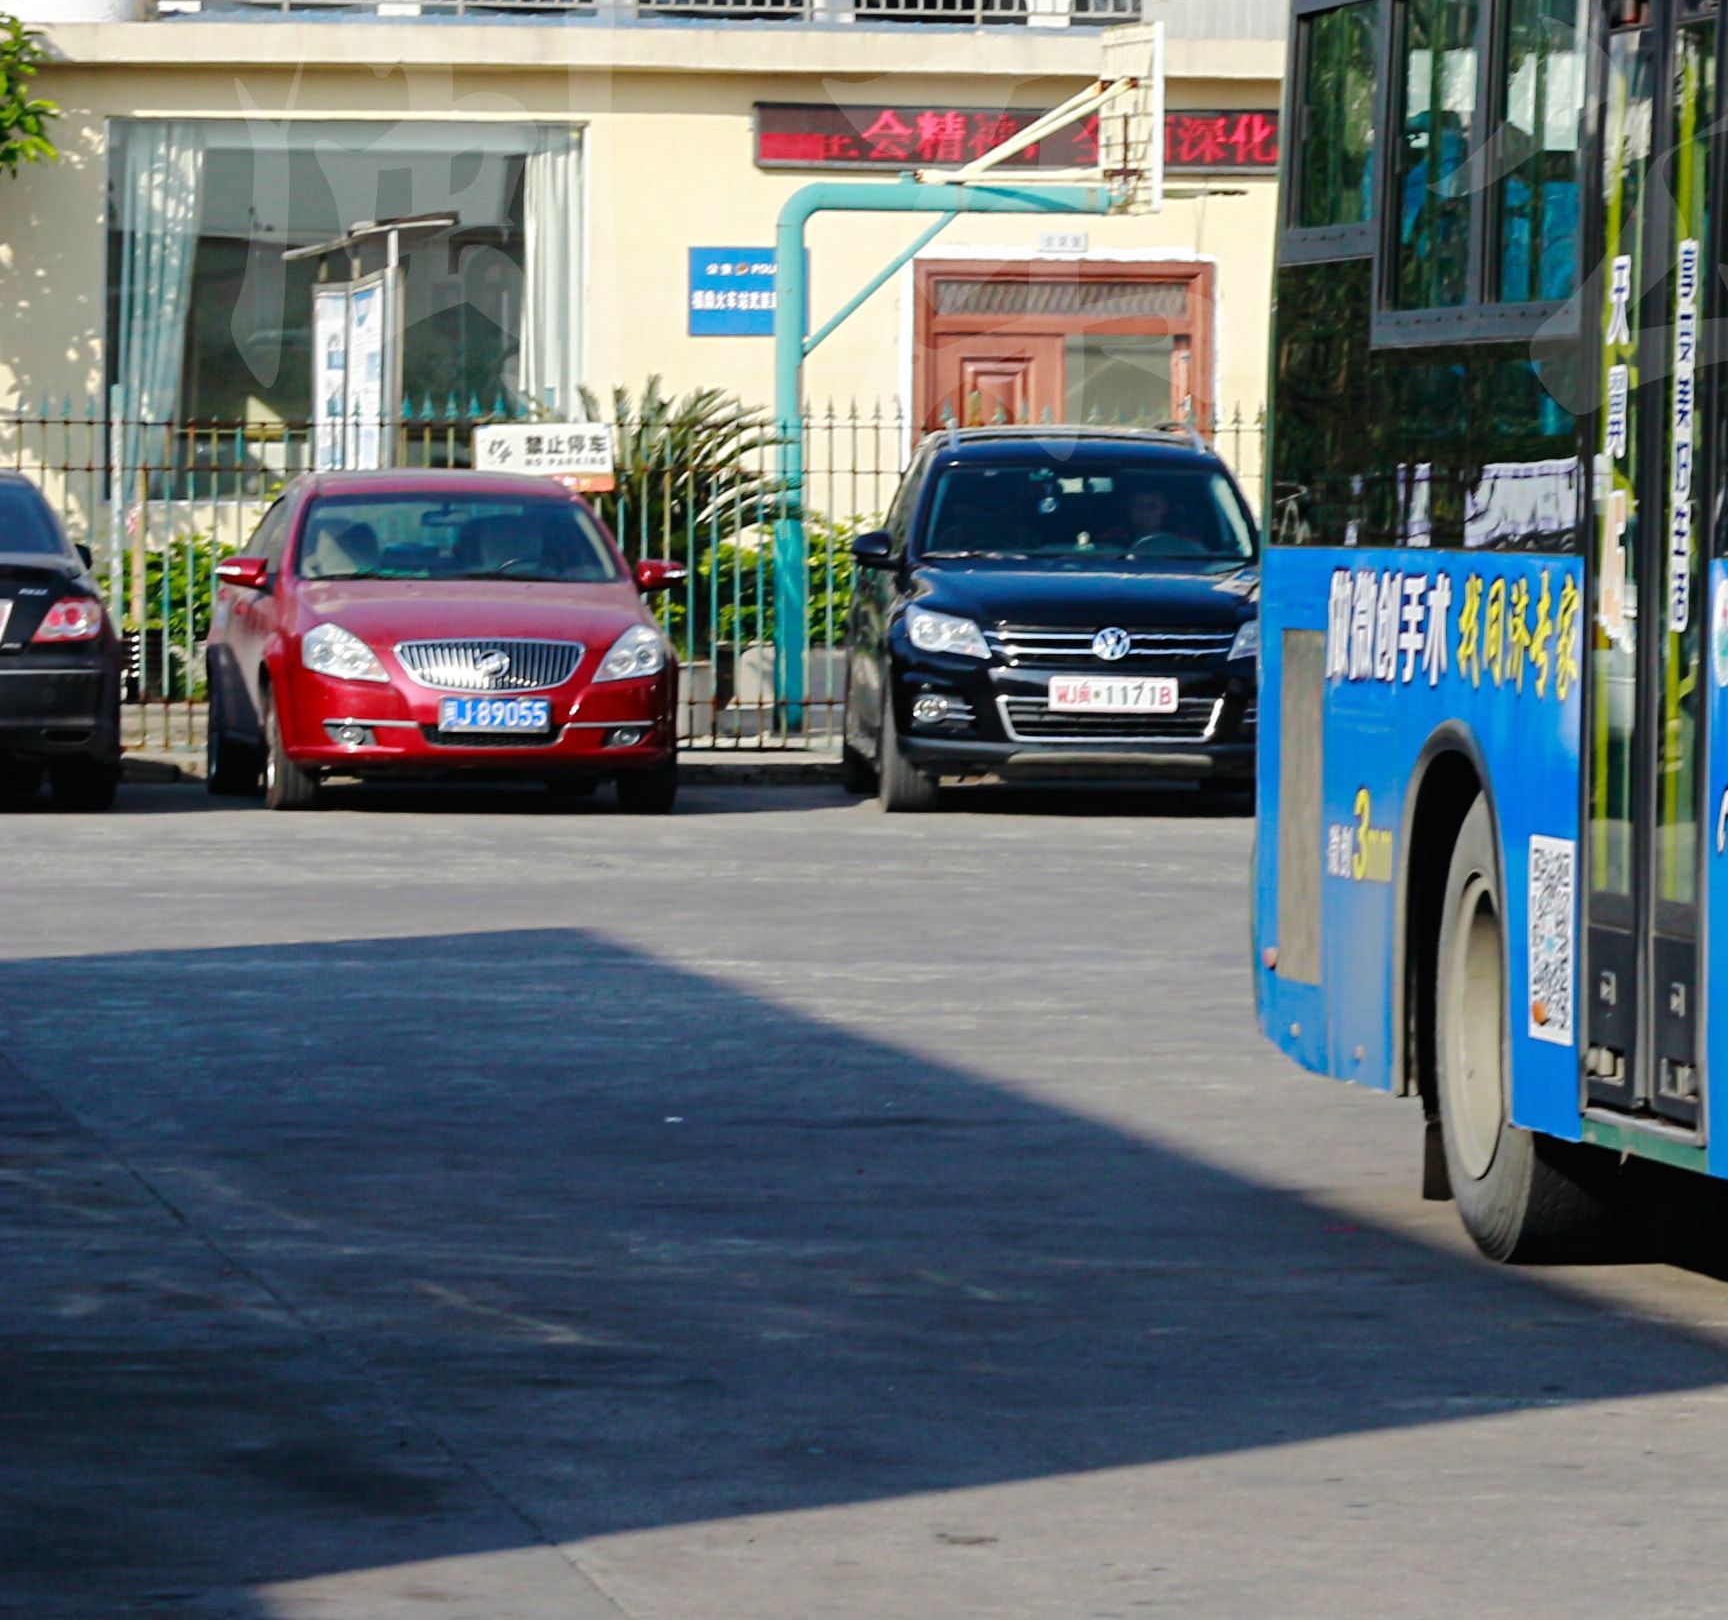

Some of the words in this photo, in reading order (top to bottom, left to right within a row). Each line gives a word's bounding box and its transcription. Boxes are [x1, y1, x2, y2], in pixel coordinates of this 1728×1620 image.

[524, 434, 609, 456] 禁止停车
[1325, 567, 1453, 687] 做微创手术
